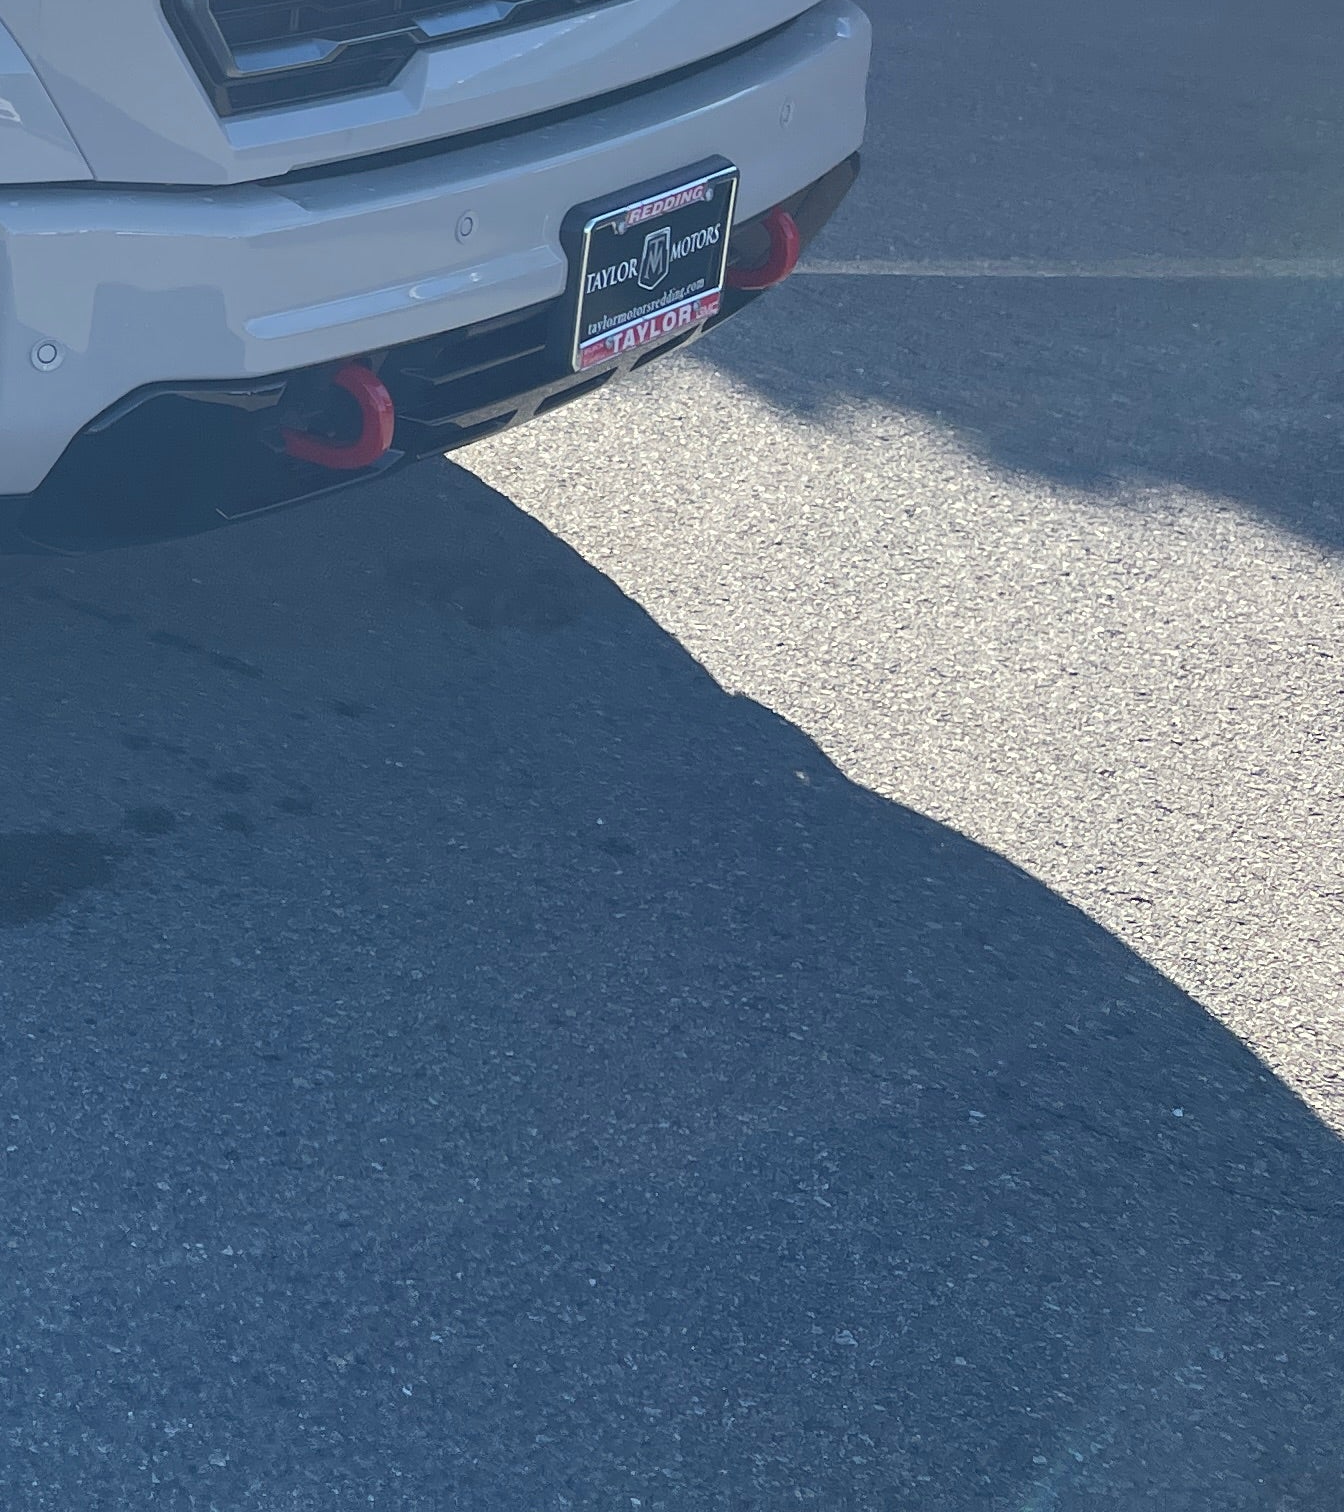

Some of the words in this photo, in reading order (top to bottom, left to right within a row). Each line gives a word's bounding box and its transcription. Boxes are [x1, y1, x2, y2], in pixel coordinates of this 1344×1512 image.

[628, 185, 705, 224] REDDING
[586, 258, 639, 294] TAYLOR
[670, 223, 721, 262] MOTORS
[612, 303, 692, 354] TAYLOR
